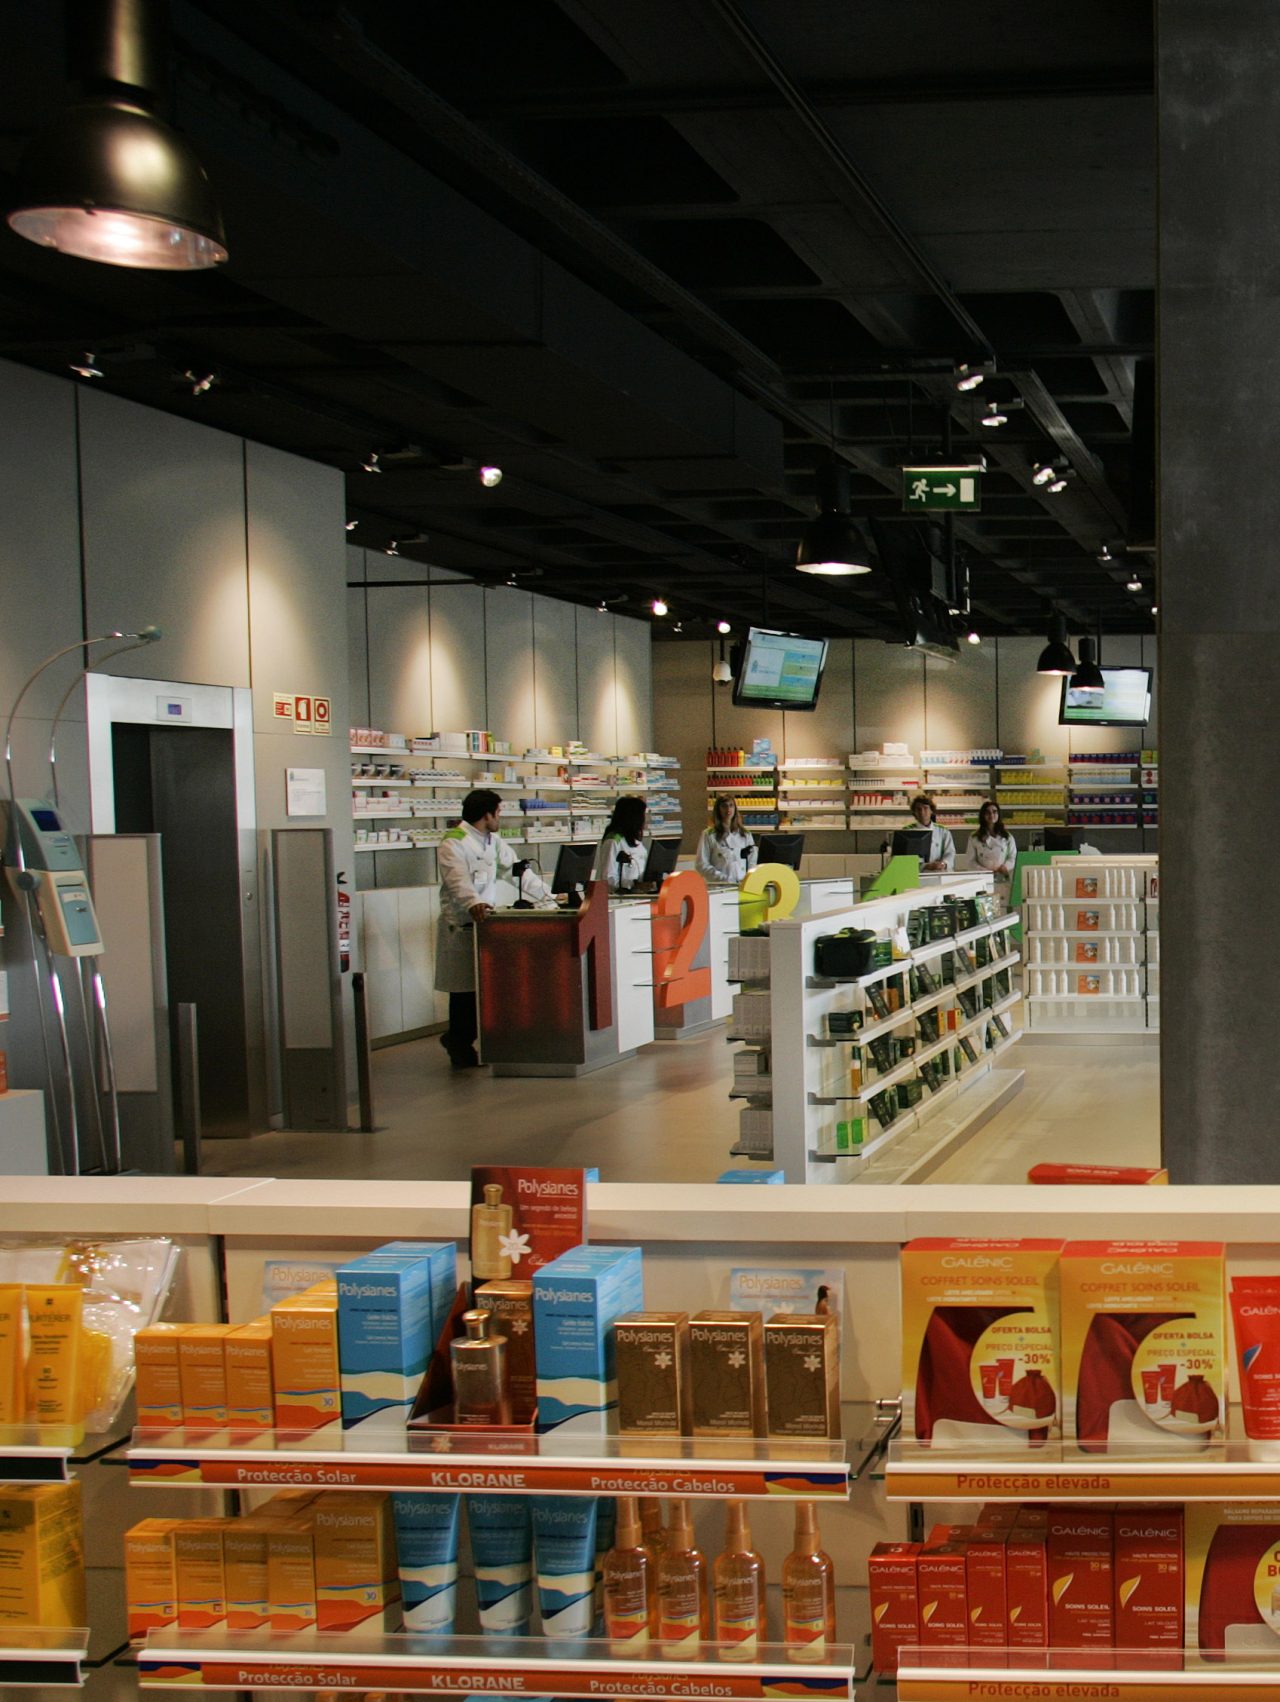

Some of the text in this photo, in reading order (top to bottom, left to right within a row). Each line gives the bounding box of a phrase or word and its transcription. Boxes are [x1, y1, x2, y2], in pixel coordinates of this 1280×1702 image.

[654, 870, 712, 1008] 2
[577, 880, 612, 1031] 1
[518, 1178, 579, 1197] Polysianes
[739, 1275, 803, 1291] Polysianes
[921, 1276, 1039, 1286] COFFRET SOINS SOLEIL
[1080, 1282, 1200, 1292] COFFRET SOINS SOLEIL
[339, 1283, 397, 1299] Polysianes
[535, 1287, 594, 1303] Polysianes
[275, 1316, 332, 1331] Polysianes
[617, 1329, 673, 1344] Polysianes
[691, 1328, 747, 1344] Polysianes
[766, 1331, 823, 1347] Polysianes
[1153, 1332, 1185, 1340] OFERTA
[1015, 1343, 1054, 1351] ESPECIAL
[1018, 1354, 1050, 1364] -30%
[1180, 1359, 1213, 1369] -30%
[237, 1469, 357, 1484] Protecção Solar
[431, 1472, 526, 1488] KLORANE
[957, 1474, 1110, 1492] Protecção elevada
[591, 1476, 736, 1494] Protecção Cabelos
[316, 1513, 375, 1529] Polysianes
[533, 1508, 588, 1524] Polysianes
[238, 1671, 357, 1686] Protecção Solar
[431, 1675, 525, 1690] KLORANE
[590, 1680, 732, 1696] Protecção Cabelos
[968, 1683, 1120, 1702] Protecção elevada
